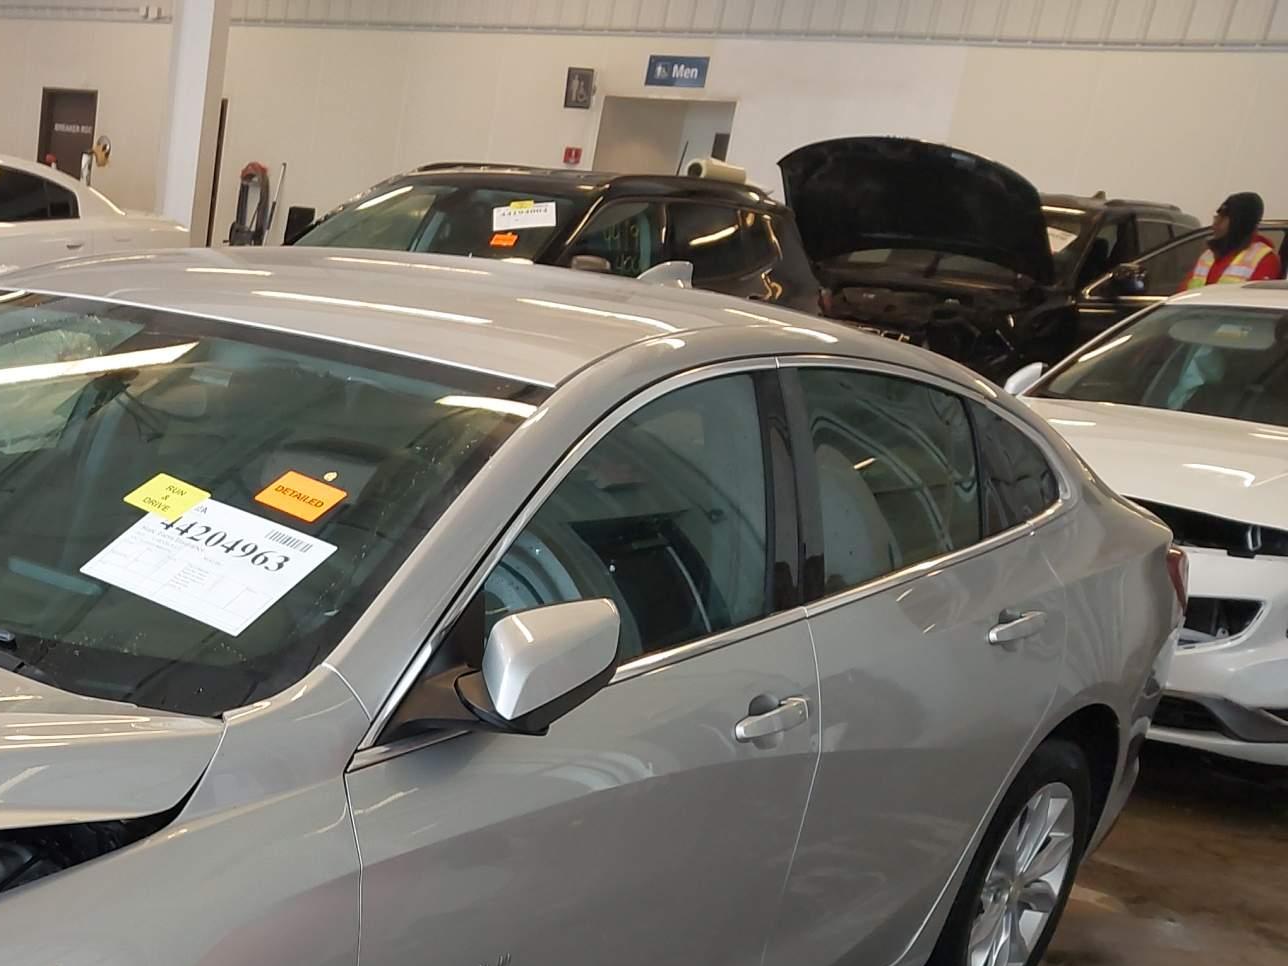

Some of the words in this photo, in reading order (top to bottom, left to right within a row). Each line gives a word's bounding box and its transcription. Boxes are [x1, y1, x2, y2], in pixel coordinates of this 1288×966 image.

[671, 63, 699, 80] Men
[165, 484, 188, 497] RUN
[274, 484, 324, 508] DETAILED
[142, 496, 171, 513] DRIVE
[160, 516, 290, 572] 44204963
